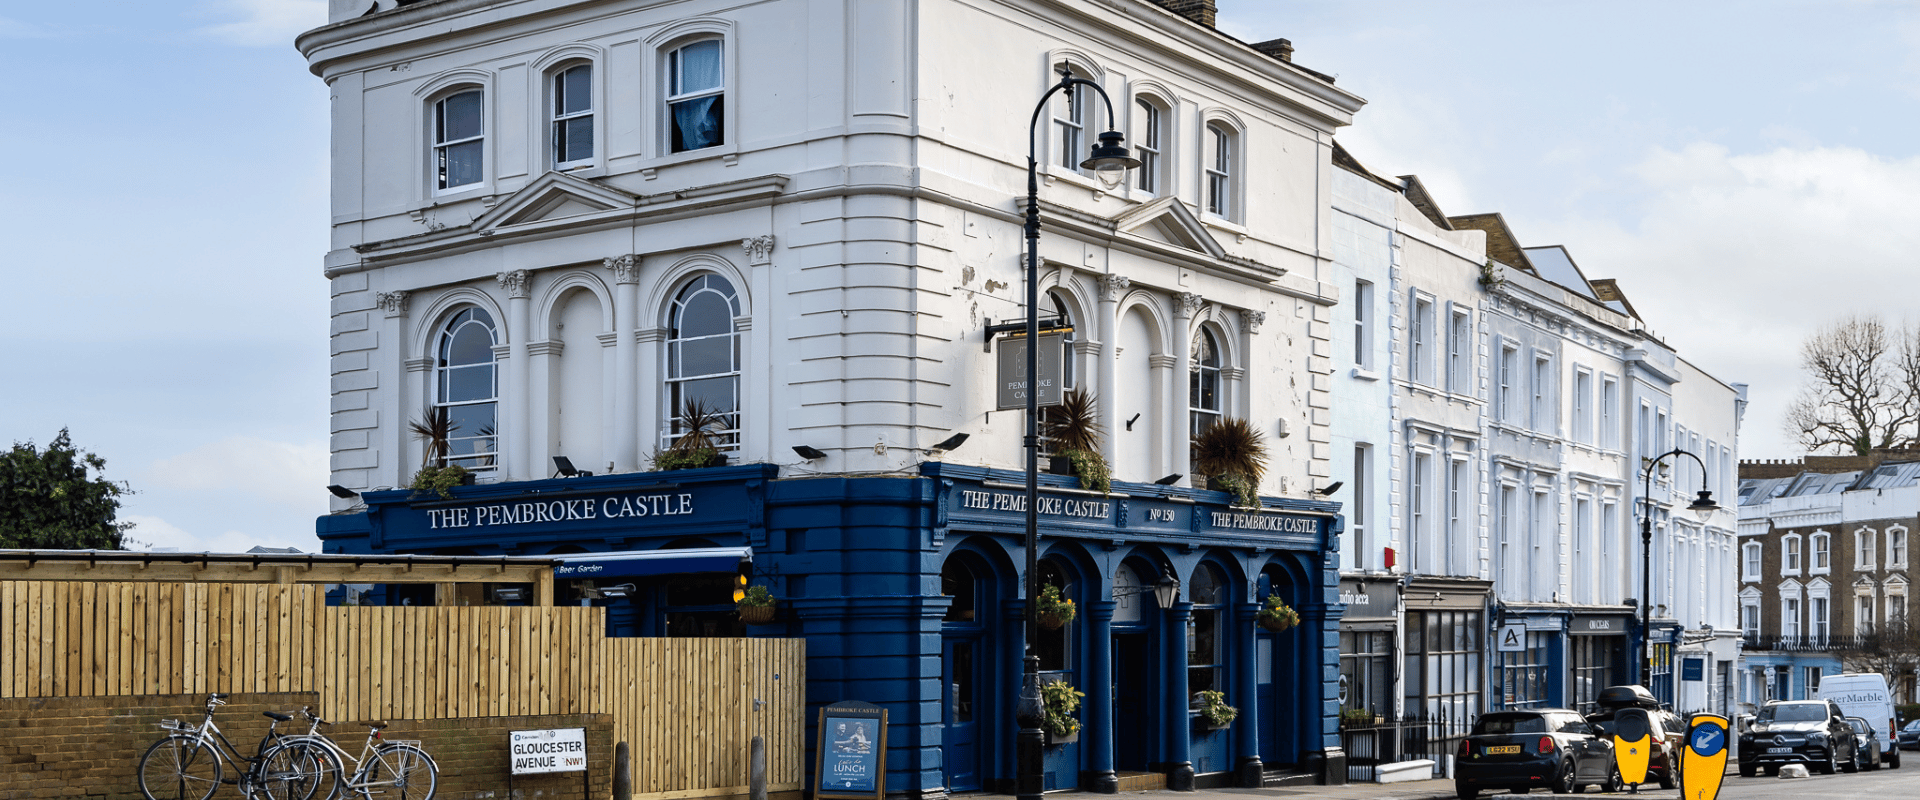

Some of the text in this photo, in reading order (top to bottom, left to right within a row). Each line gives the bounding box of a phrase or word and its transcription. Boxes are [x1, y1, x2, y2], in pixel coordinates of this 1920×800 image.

[1008, 379, 1051, 390] PEMKE
[1014, 389, 1045, 399] CAE
[963, 490, 1110, 519] THE PEMBOKE CASTLE
[427, 493, 693, 529] THE PEMBROKE CASTLE
[1162, 509, 1175, 521] 150
[1211, 511, 1317, 534] THE PEMBROKE CASTLE
[559, 564, 603, 574] Beer Garden
[1355, 594, 1370, 605] acca
[513, 741, 582, 755] GLOUCESTER
[515, 756, 583, 769] AVENUE NW1
[833, 764, 866, 773] LUNCH
